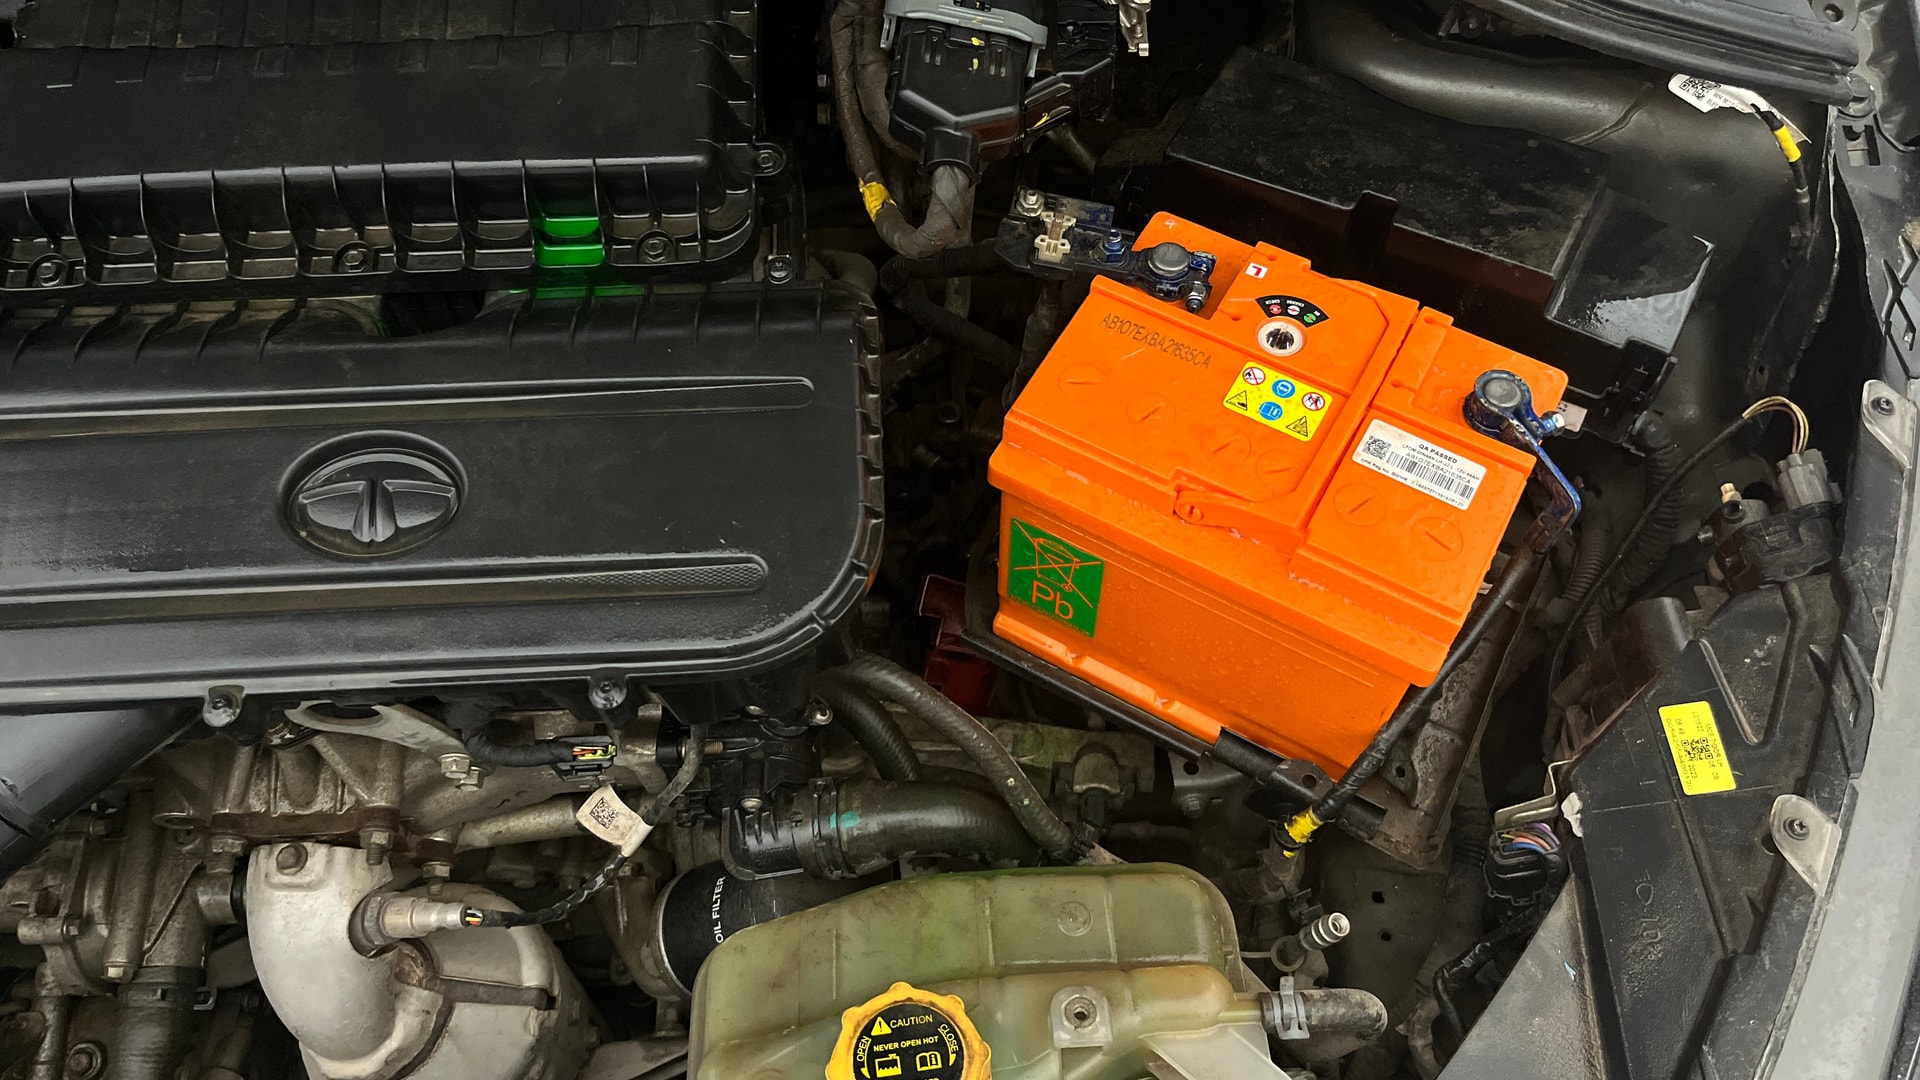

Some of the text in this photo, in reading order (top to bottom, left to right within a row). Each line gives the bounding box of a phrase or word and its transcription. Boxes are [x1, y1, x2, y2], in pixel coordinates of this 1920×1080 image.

[1100, 313, 1212, 369] AB107EXBA21635CA
[1418, 443, 1458, 464] QA PASSED
[1032, 579, 1074, 620] Pb
[712, 875, 726, 944] OIL FILTER
[890, 1015, 933, 1028] CAUTION
[856, 1035, 870, 1062] OPEN
[873, 1036, 939, 1052] NEVER OPEN HOT
[939, 1023, 959, 1053] CLOSE
